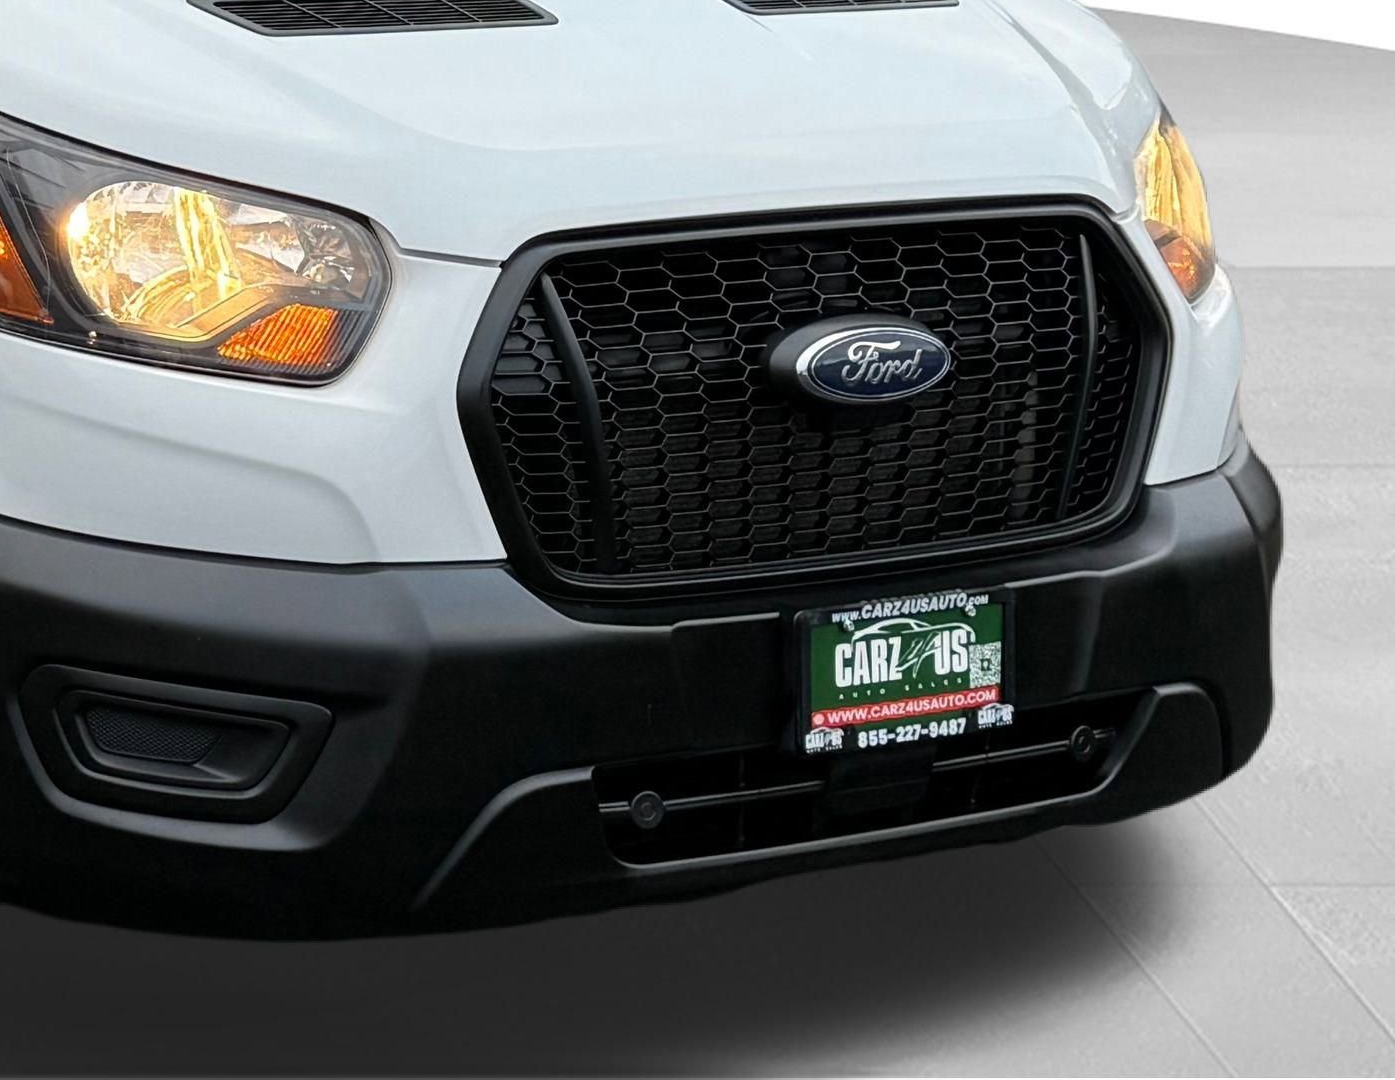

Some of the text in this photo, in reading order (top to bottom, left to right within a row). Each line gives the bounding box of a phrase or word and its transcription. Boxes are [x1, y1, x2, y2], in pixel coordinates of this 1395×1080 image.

[841, 340, 923, 384] Ford
[827, 688, 996, 724] WWW.CARZ4USAUTO.COM
[857, 717, 967, 749] 855-227-9487
